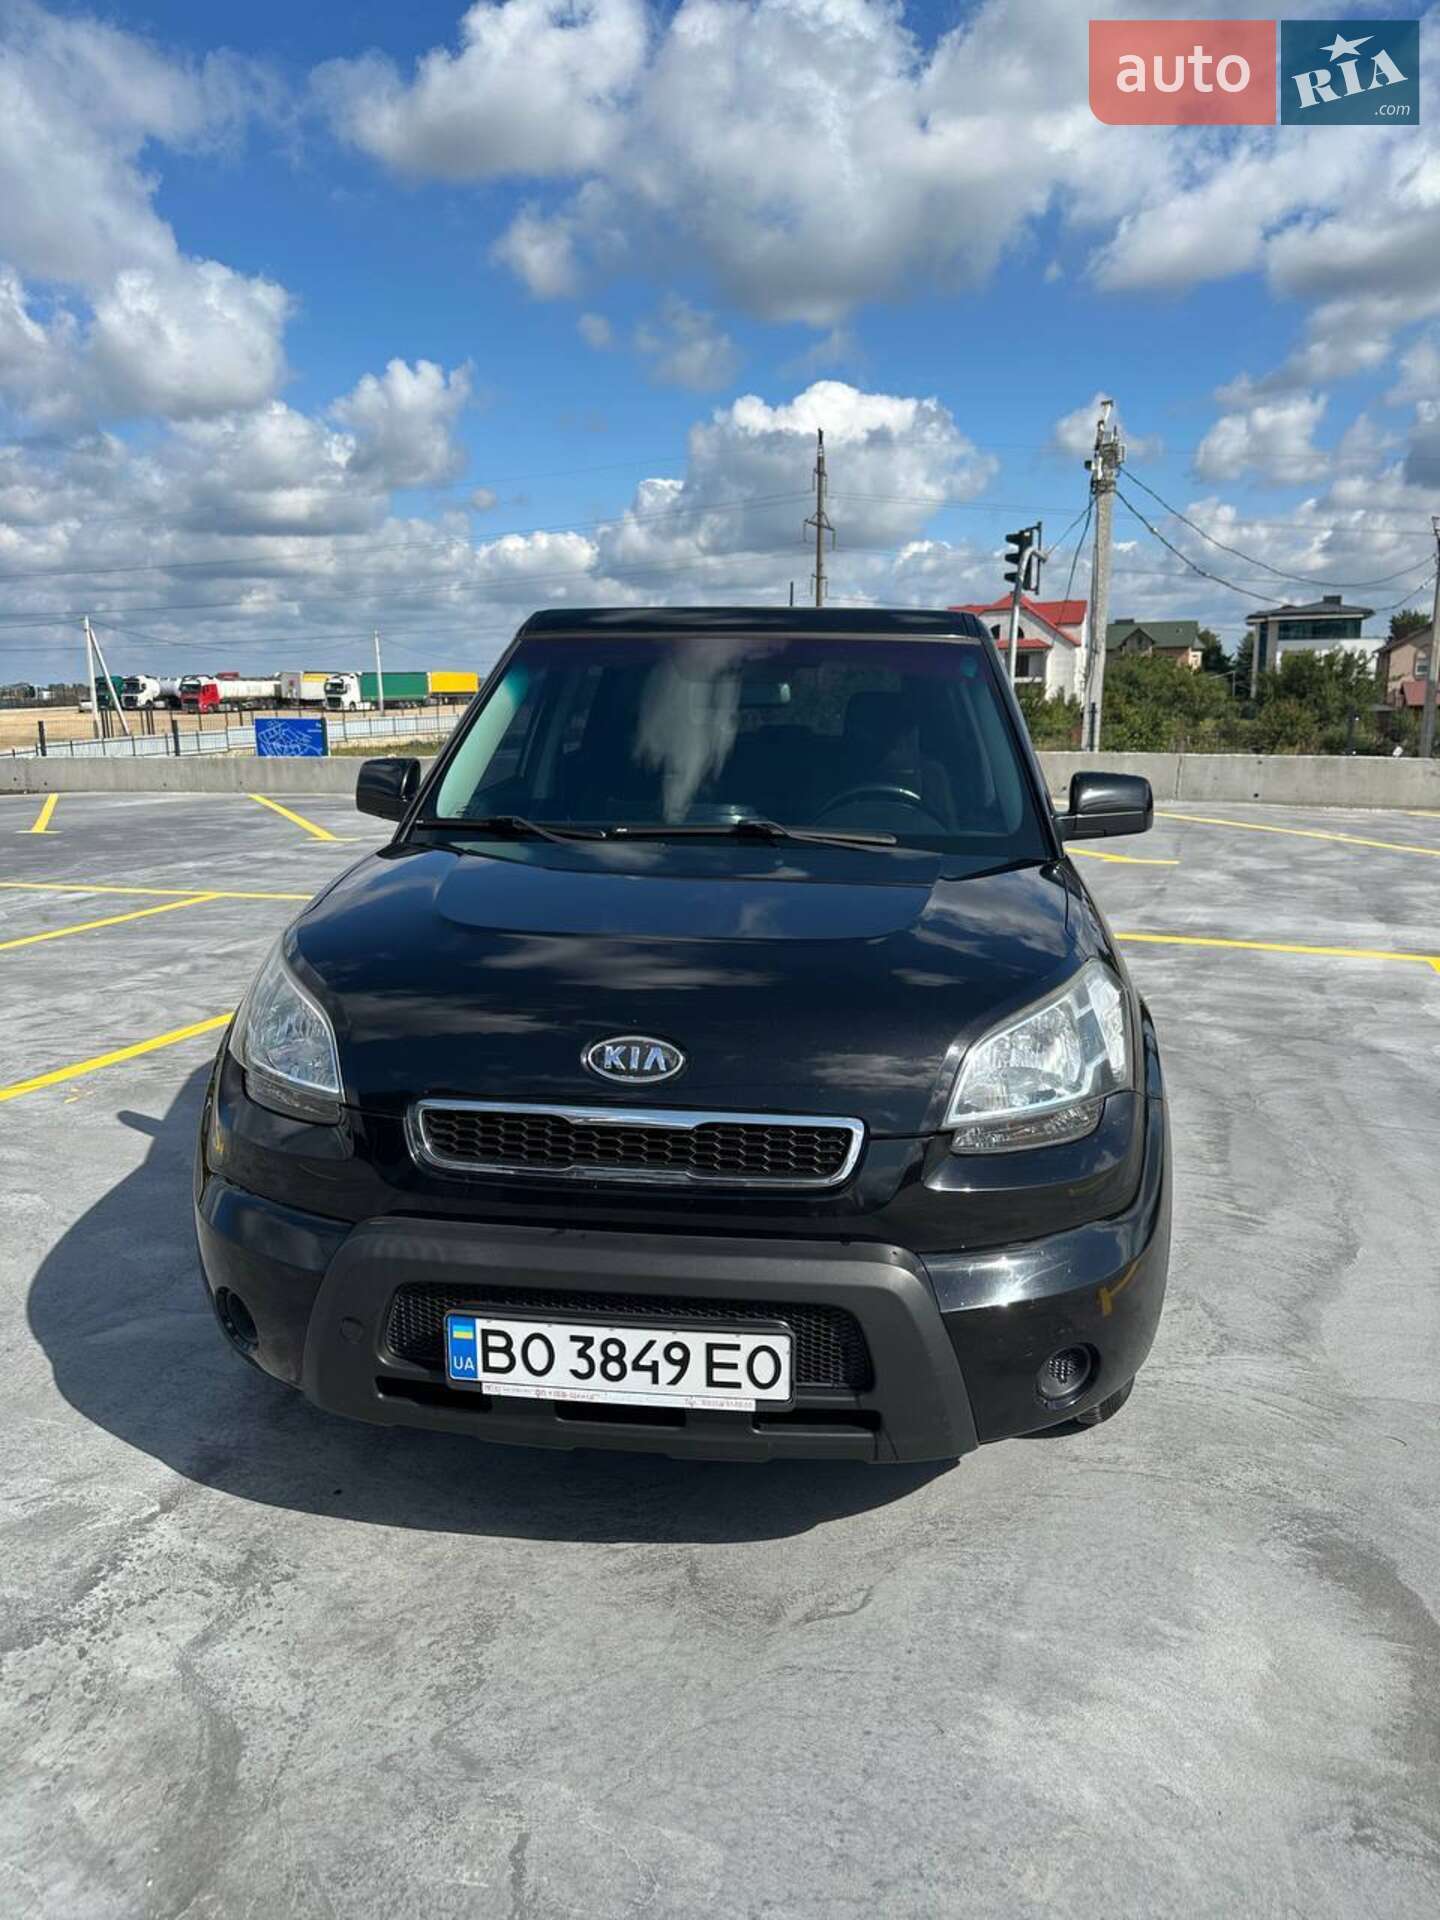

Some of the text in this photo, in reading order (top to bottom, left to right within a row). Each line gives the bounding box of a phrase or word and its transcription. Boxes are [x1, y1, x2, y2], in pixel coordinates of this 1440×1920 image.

[603, 1044, 667, 1072] KIA
[453, 1355, 475, 1371] UA
[480, 1328, 783, 1390] BO 3849 EO
